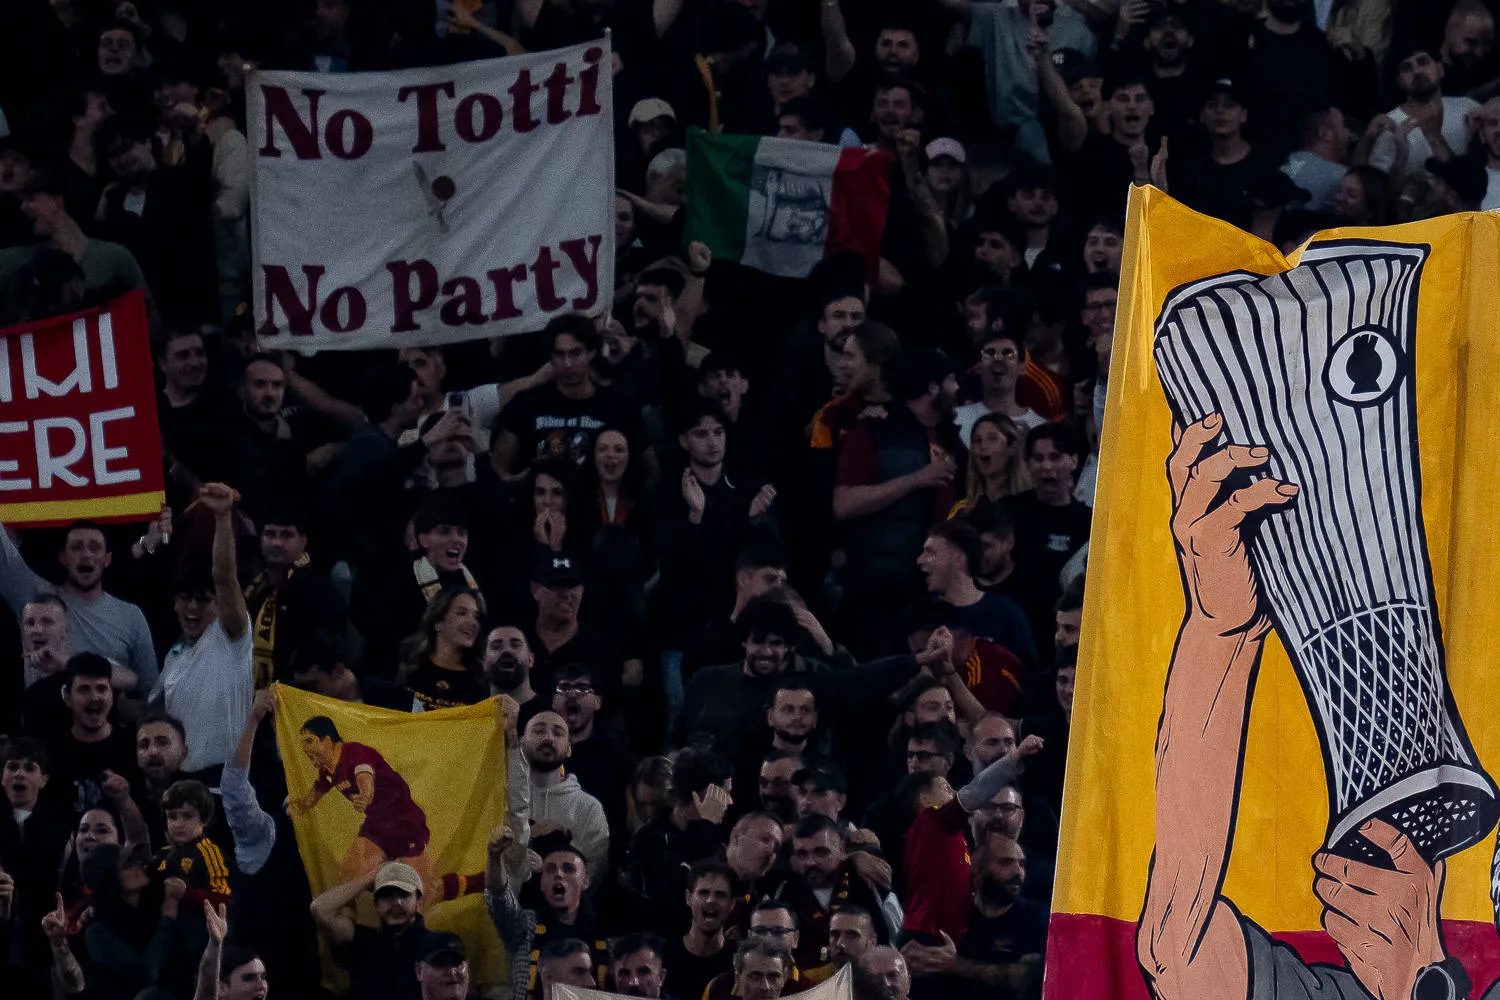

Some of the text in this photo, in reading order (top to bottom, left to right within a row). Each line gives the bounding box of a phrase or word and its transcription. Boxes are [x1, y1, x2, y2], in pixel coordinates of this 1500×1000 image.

[259, 48, 604, 160] No Totti
[258, 234, 603, 338] No Party
[0, 313, 119, 403] MI
